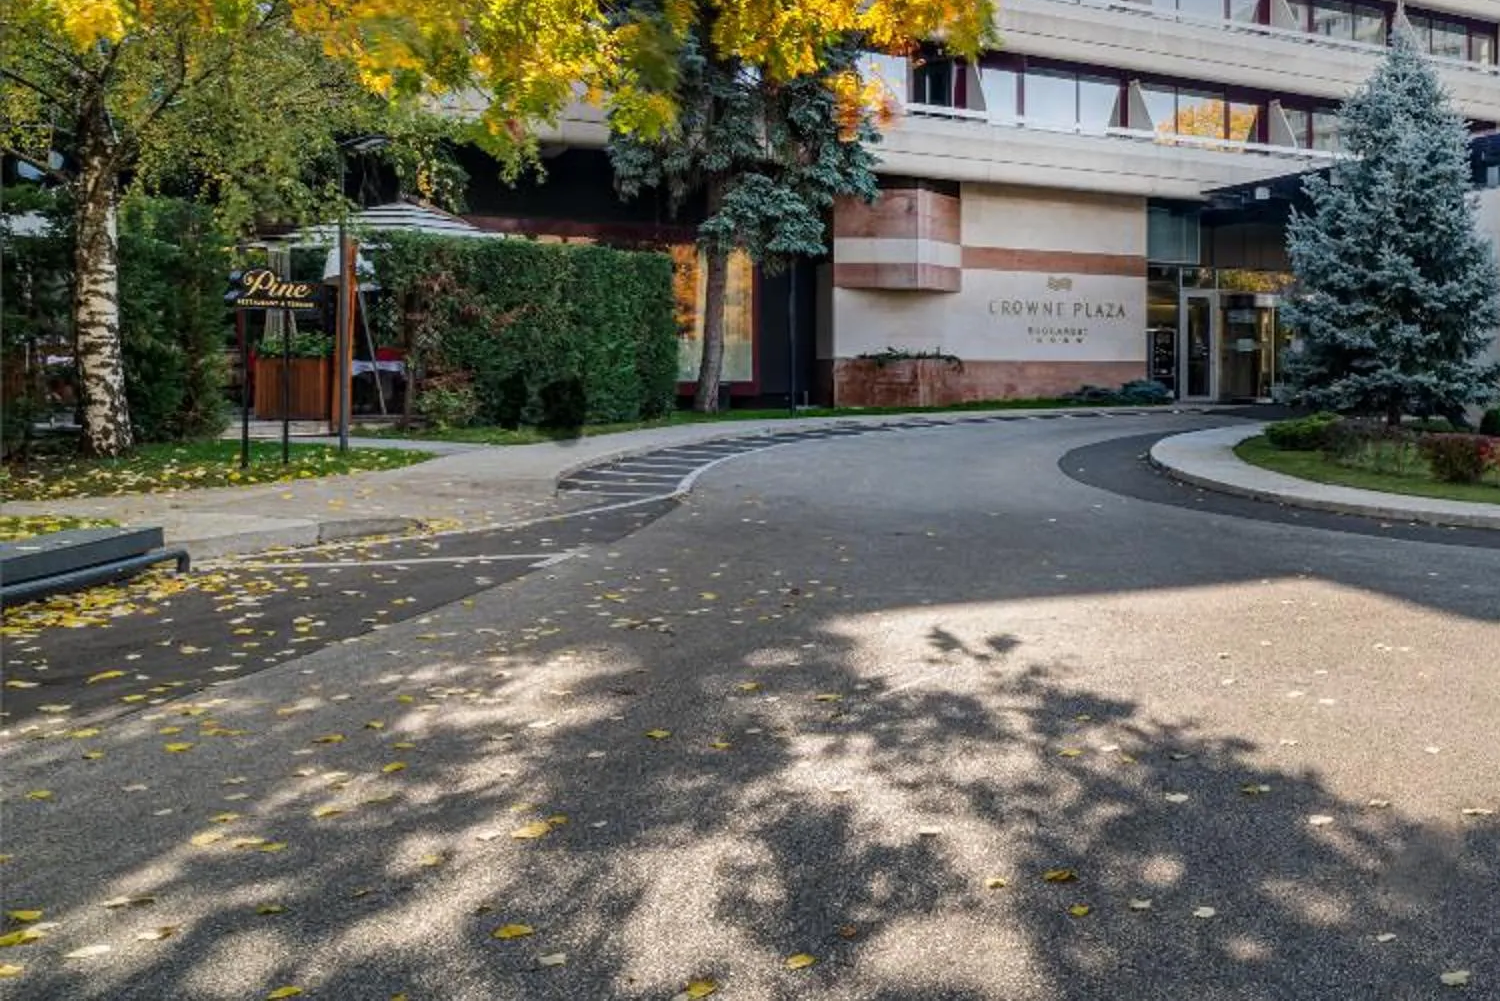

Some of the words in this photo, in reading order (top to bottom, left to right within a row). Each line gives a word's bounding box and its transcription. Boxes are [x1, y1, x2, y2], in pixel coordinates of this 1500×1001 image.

[243, 269, 313, 298] Pine
[988, 300, 1065, 317] CROWNE
[1073, 302, 1126, 319] PLAZA
